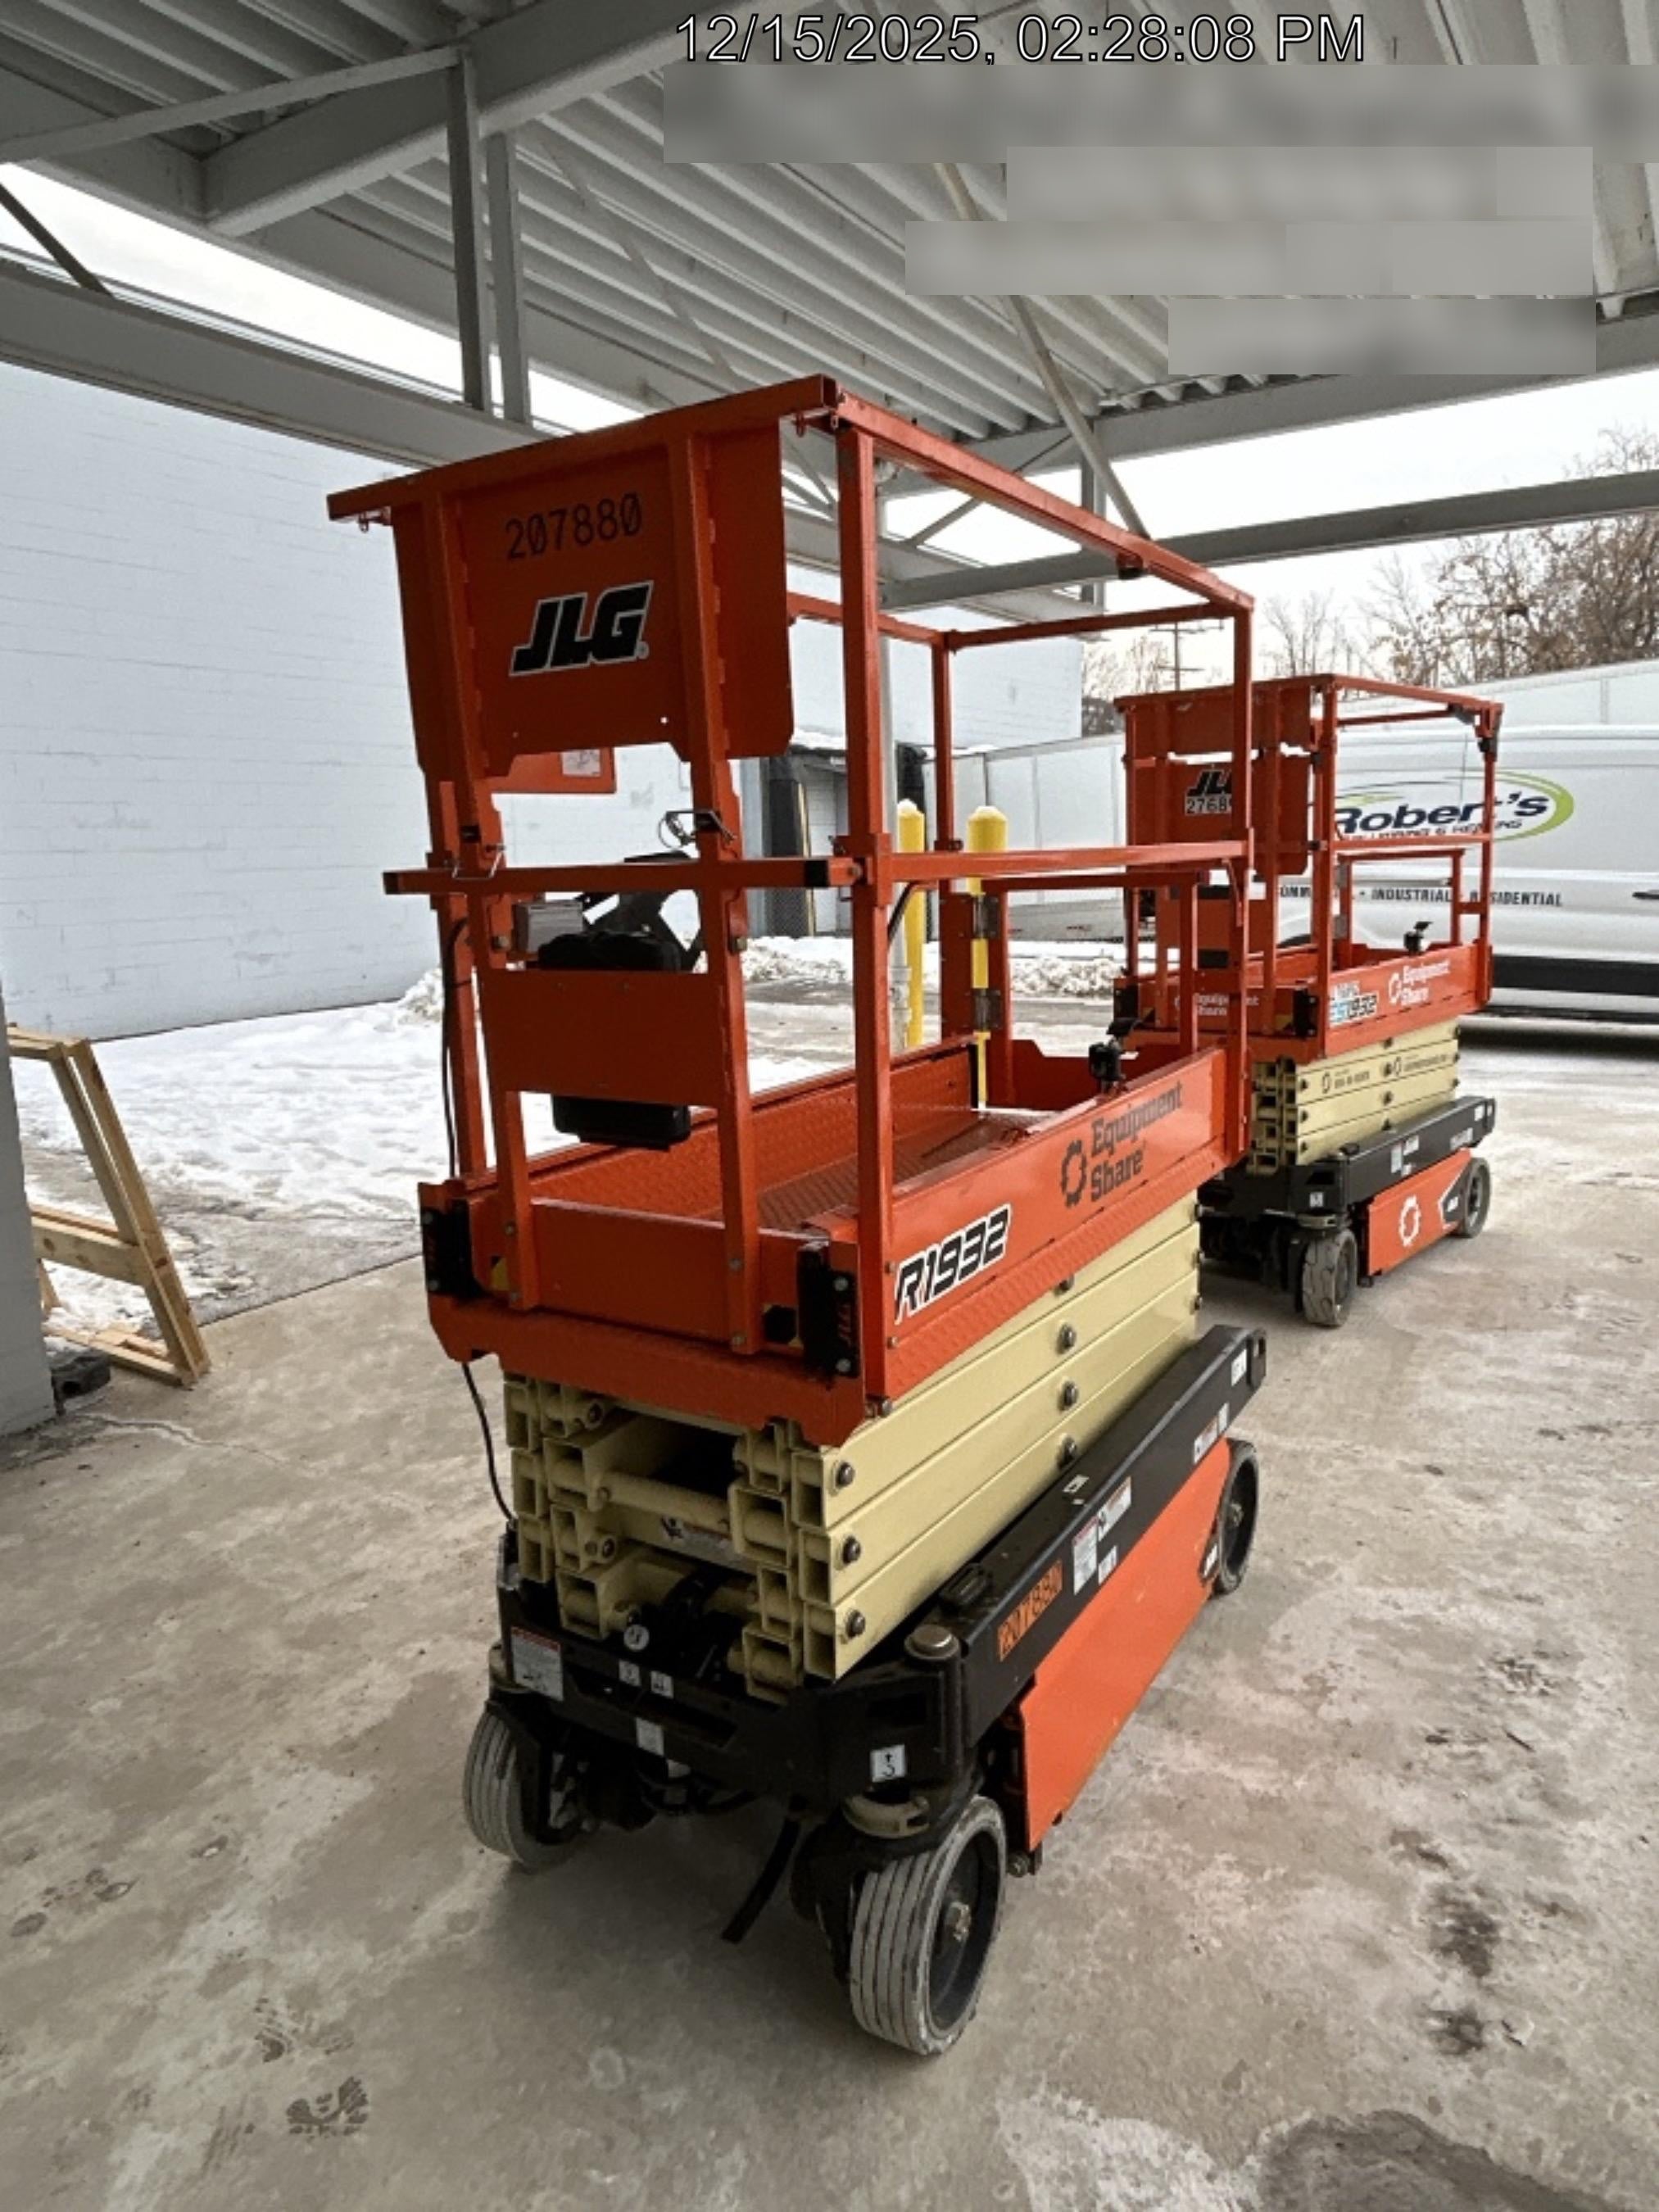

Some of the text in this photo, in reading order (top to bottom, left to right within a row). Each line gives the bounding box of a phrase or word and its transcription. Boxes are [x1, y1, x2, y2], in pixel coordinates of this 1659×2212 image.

[505, 492, 642, 562] 207880
[508, 580, 655, 677] JLG
[1371, 887, 1453, 903] INDUSTRIAL
[1469, 891, 1562, 908] RSIDENTIAL
[1091, 1080, 1182, 1158] Equipment
[1091, 1149, 1144, 1203] Share
[895, 1204, 1011, 1325] R1932
